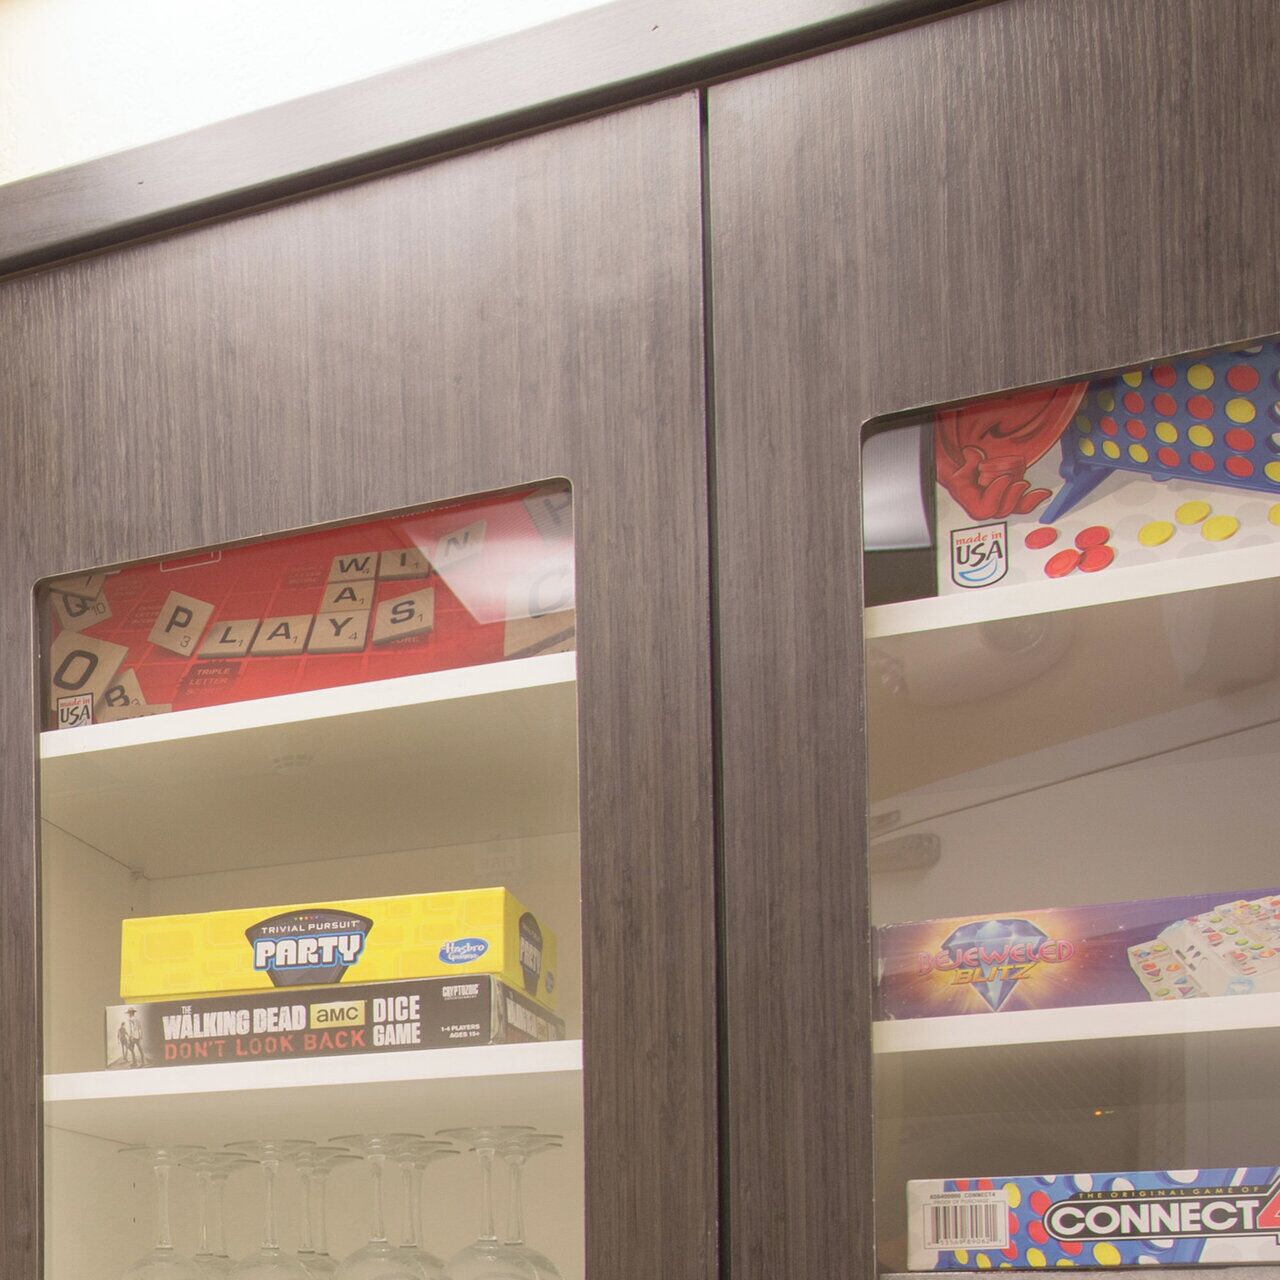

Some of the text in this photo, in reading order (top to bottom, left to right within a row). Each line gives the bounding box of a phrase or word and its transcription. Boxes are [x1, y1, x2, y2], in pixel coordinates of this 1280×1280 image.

[956, 531, 1001, 545] made in
[956, 540, 1003, 567] USA
[60, 705, 90, 726] USA
[261, 920, 357, 935] TRIVIAL PURSUIT
[255, 934, 361, 969] PARTY
[445, 942, 485, 954] Hasbro
[917, 937, 1075, 976] BEJEWELED
[951, 963, 1037, 986] BLITZ
[442, 984, 479, 997] CRYPTOZOIC
[373, 995, 420, 1023] DICE
[162, 1009, 250, 1040] WALKING
[253, 1004, 306, 1034] DEAD
[451, 1023, 480, 1032] PLAYERS
[164, 1029, 366, 1060] DON'T LOOK BACK
[373, 1022, 421, 1046] GAME
[1078, 1192, 1103, 1200] THE
[1111, 1188, 1186, 1198] ORIGINAL
[1192, 1187, 1227, 1195] GAME
[1051, 1200, 1259, 1236] CONNECT
